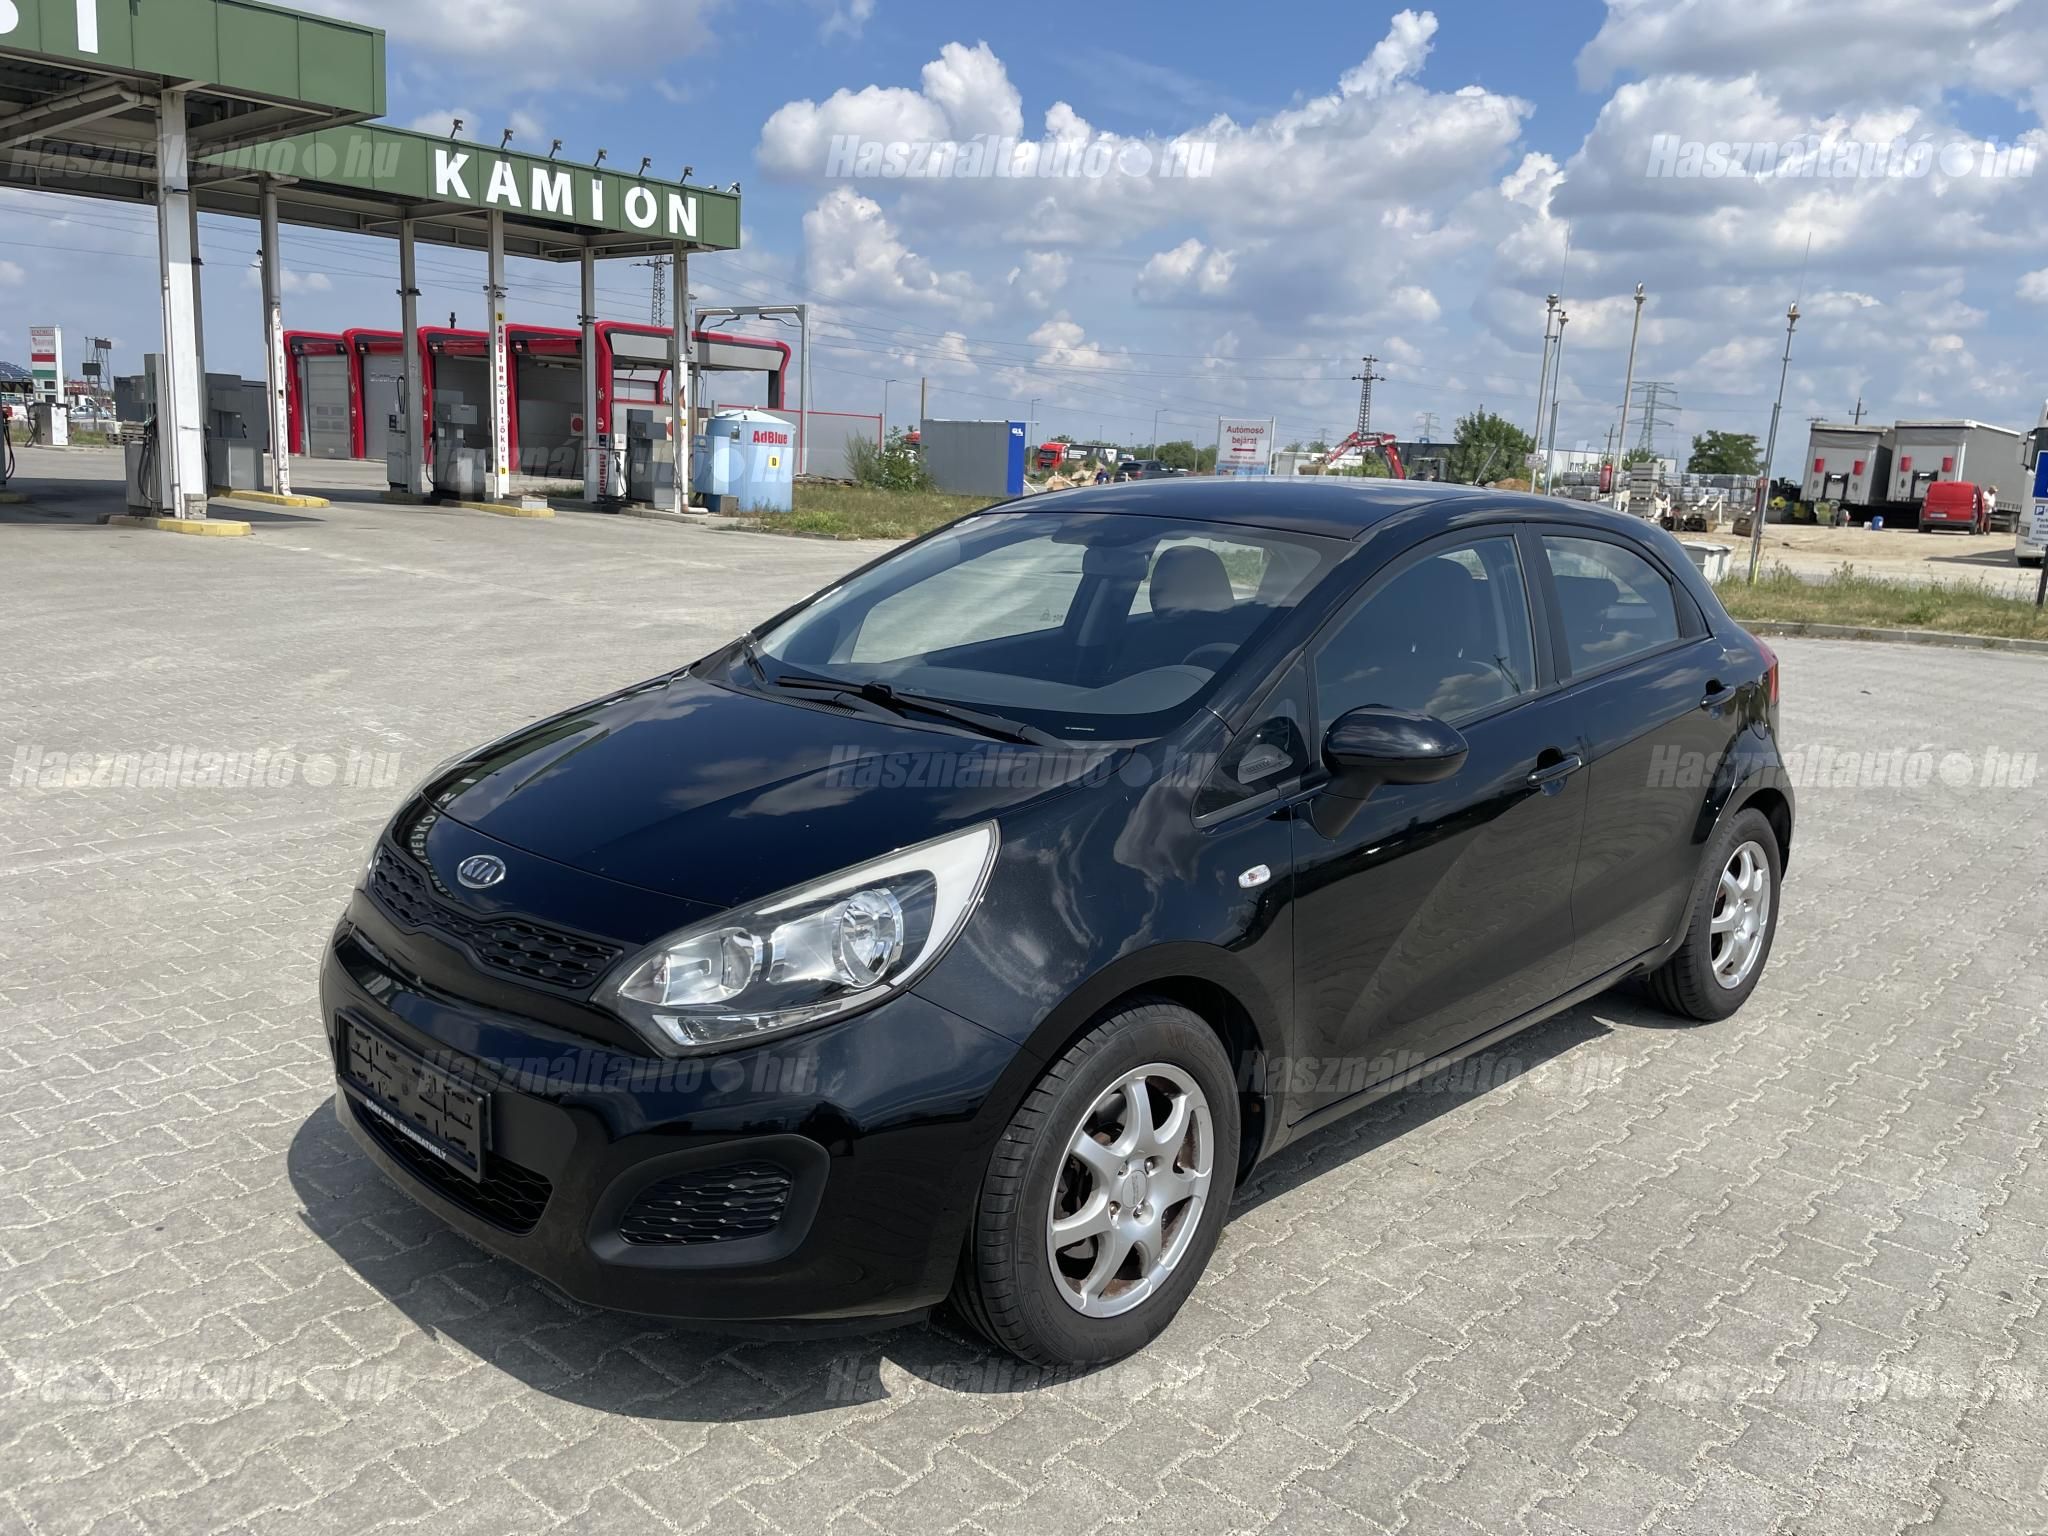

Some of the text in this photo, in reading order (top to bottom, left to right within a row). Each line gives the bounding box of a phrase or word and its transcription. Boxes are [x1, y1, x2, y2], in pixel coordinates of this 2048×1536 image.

[435, 149, 697, 237] KAMION
[752, 430, 788, 445] AdBlue
[463, 858, 498, 884] KIA
